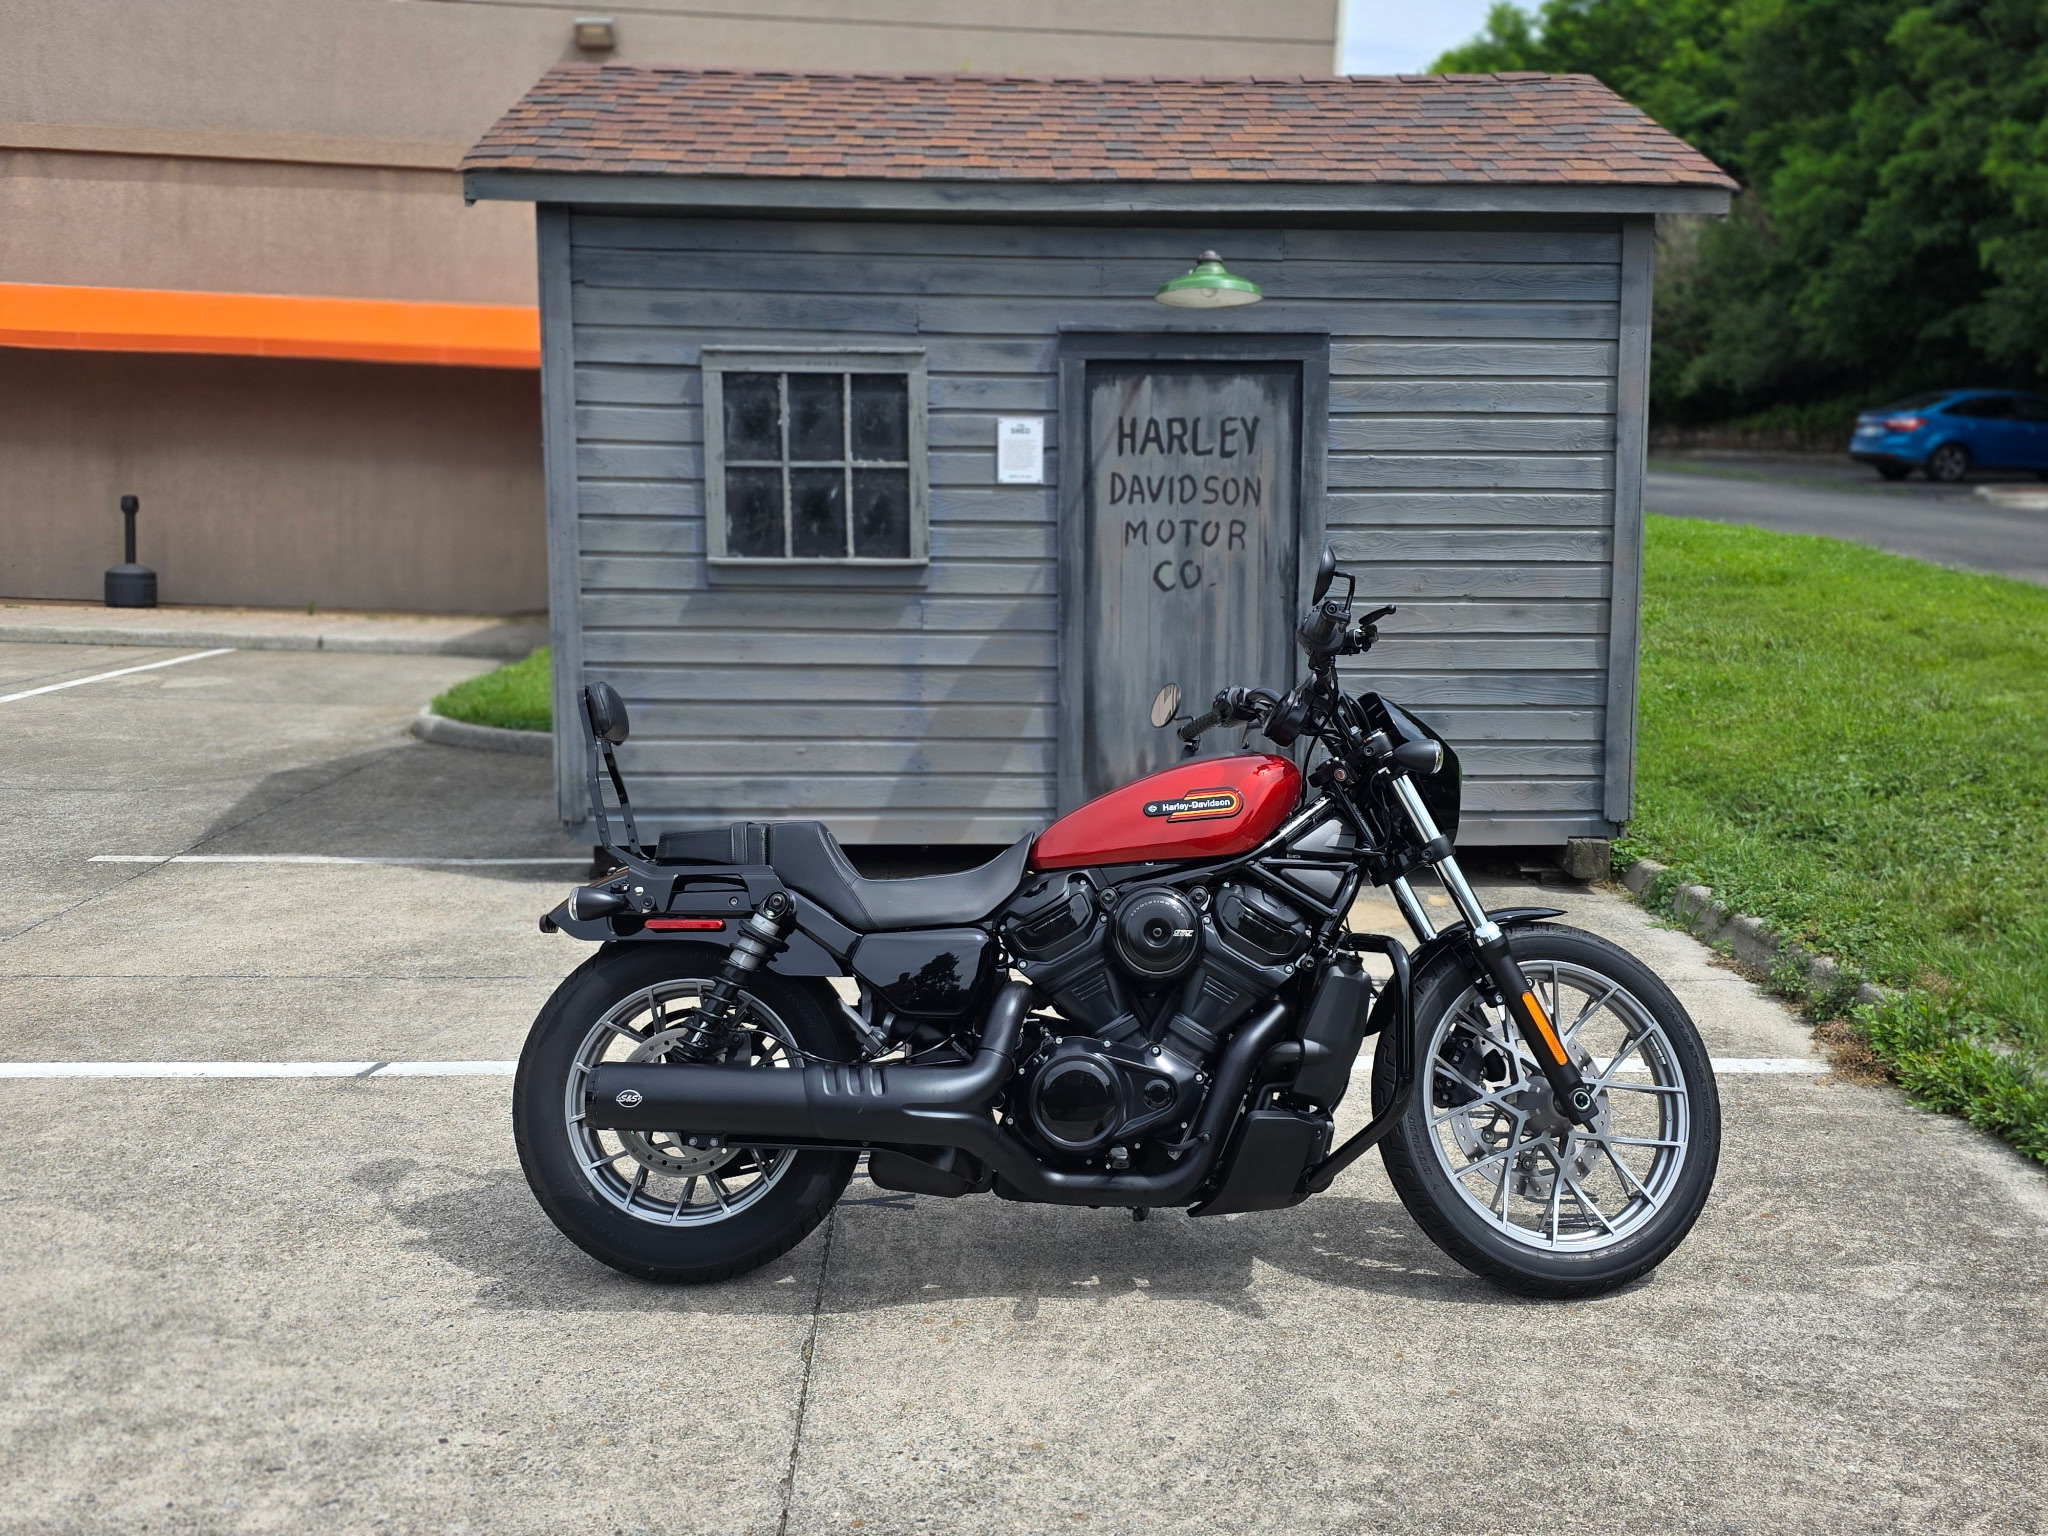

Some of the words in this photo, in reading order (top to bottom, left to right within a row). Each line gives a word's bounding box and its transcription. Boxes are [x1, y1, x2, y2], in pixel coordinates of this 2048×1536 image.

[1117, 416, 1261, 458] HARLEY
[1109, 472, 1262, 507] DAVIDSON
[1125, 517, 1247, 551] MOTOR
[1162, 799, 1231, 811] Harley-Davidson
